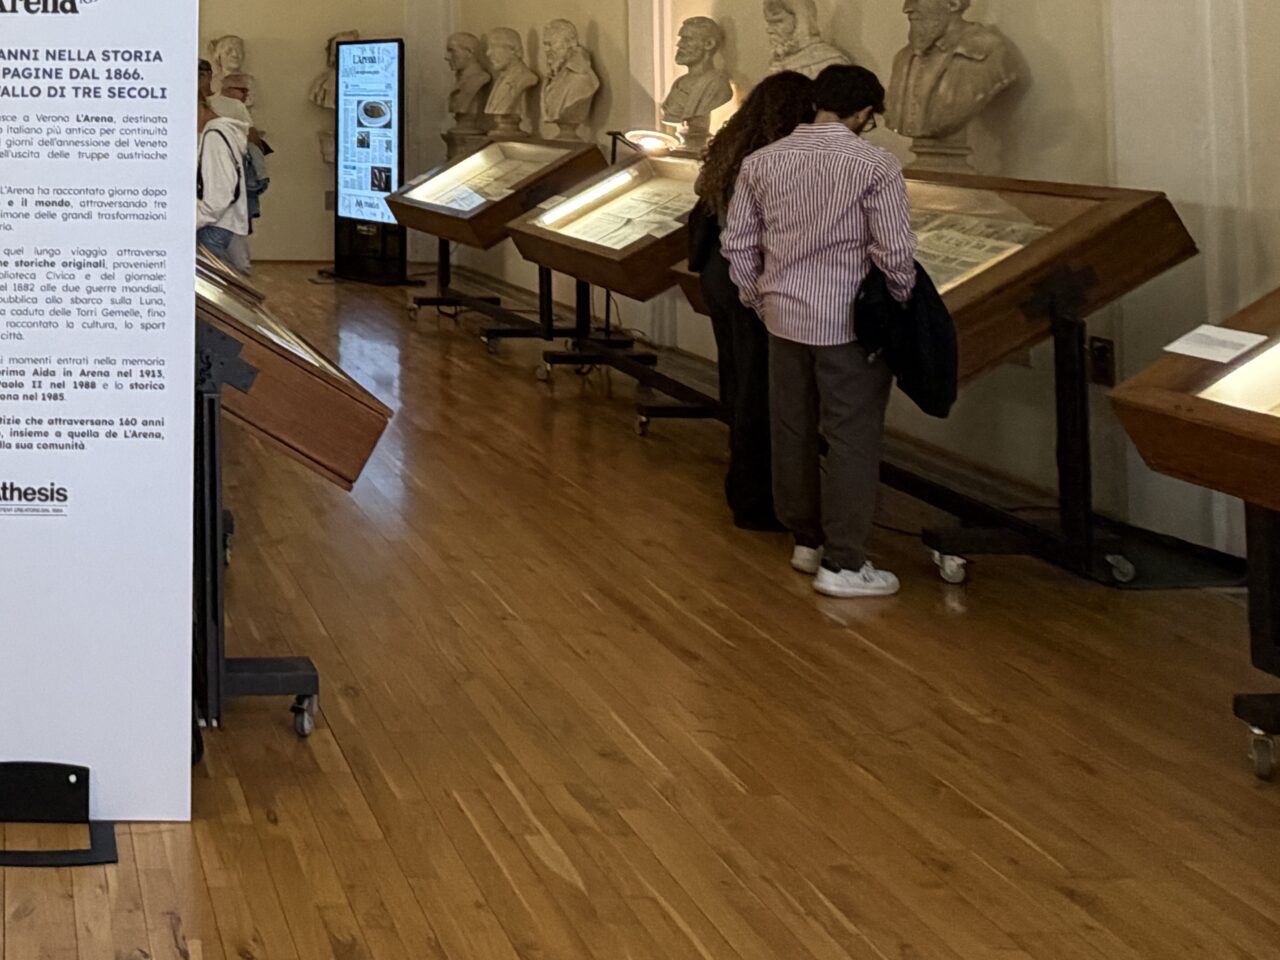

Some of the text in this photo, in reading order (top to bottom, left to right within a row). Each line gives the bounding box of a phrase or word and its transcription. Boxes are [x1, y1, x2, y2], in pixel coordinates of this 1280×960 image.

[45, 49, 96, 62] NELLA
[101, 50, 163, 62] STORIA
[2, 67, 63, 79] PAGINE
[69, 68, 100, 80] DAL
[105, 68, 144, 80] 1866.
[47, 86, 66, 98] DI
[71, 86, 102, 98] TRE
[107, 87, 167, 99] SECOLI
[36, 114, 70, 122] Verona
[76, 114, 116, 123] L'Arena,
[122, 115, 168, 123] destinata
[7, 126, 43, 134] italiano
[46, 126, 61, 136] più
[100, 128, 116, 136] per
[119, 127, 168, 135] continuità
[6, 137, 33, 148] giorni
[38, 138, 110, 147] dell'annessione
[114, 139, 129, 147] del
[134, 140, 168, 148] Veneto
[78, 151, 110, 161] truppe
[117, 151, 168, 159] austriache
[0, 186, 34, 197] L'Arena
[38, 186, 50, 195] ha
[108, 187, 139, 198] giorno
[142, 188, 167, 197] dopo
[21, 197, 28, 207] il
[35, 198, 73, 208] mondo,
[79, 200, 148, 208] attraversando
[154, 200, 167, 208] tre
[61, 211, 92, 222] grandi
[98, 211, 166, 220] trasformazioni
[71, 247, 107, 258] viaggio
[14, 258, 56, 267] storiche
[61, 259, 108, 270] originali,
[113, 260, 166, 270] provenienti
[62, 284, 80, 292] due
[85, 286, 117, 294] guerre
[70, 294, 103, 304] sbarco
[140, 297, 166, 306] Luna,
[10, 307, 44, 316] caduta
[76, 308, 97, 316] Torri
[147, 309, 166, 317] fino
[6, 320, 59, 328] raccontato
[81, 320, 118, 330] cultura,
[140, 322, 166, 331] sport
[0, 331, 24, 340] città.
[8, 356, 51, 364] momenti
[56, 357, 88, 365] entrati
[122, 357, 165, 365] memoria
[32, 367, 56, 377] Aida
[63, 368, 72, 377] in
[79, 369, 110, 377] Arena
[117, 369, 132, 378] nel
[32, 380, 42, 389] II
[50, 380, 66, 389] nel
[129, 381, 165, 390] storico
[22, 392, 38, 401] nel
[25, 416, 44, 425] che
[47, 418, 114, 426] attraversano
[119, 418, 137, 426] 160
[141, 417, 164, 427] anni
[10, 428, 49, 437] insieme
[67, 429, 100, 440] quella
[105, 429, 118, 438] de
[124, 430, 164, 440] L'Arena,
